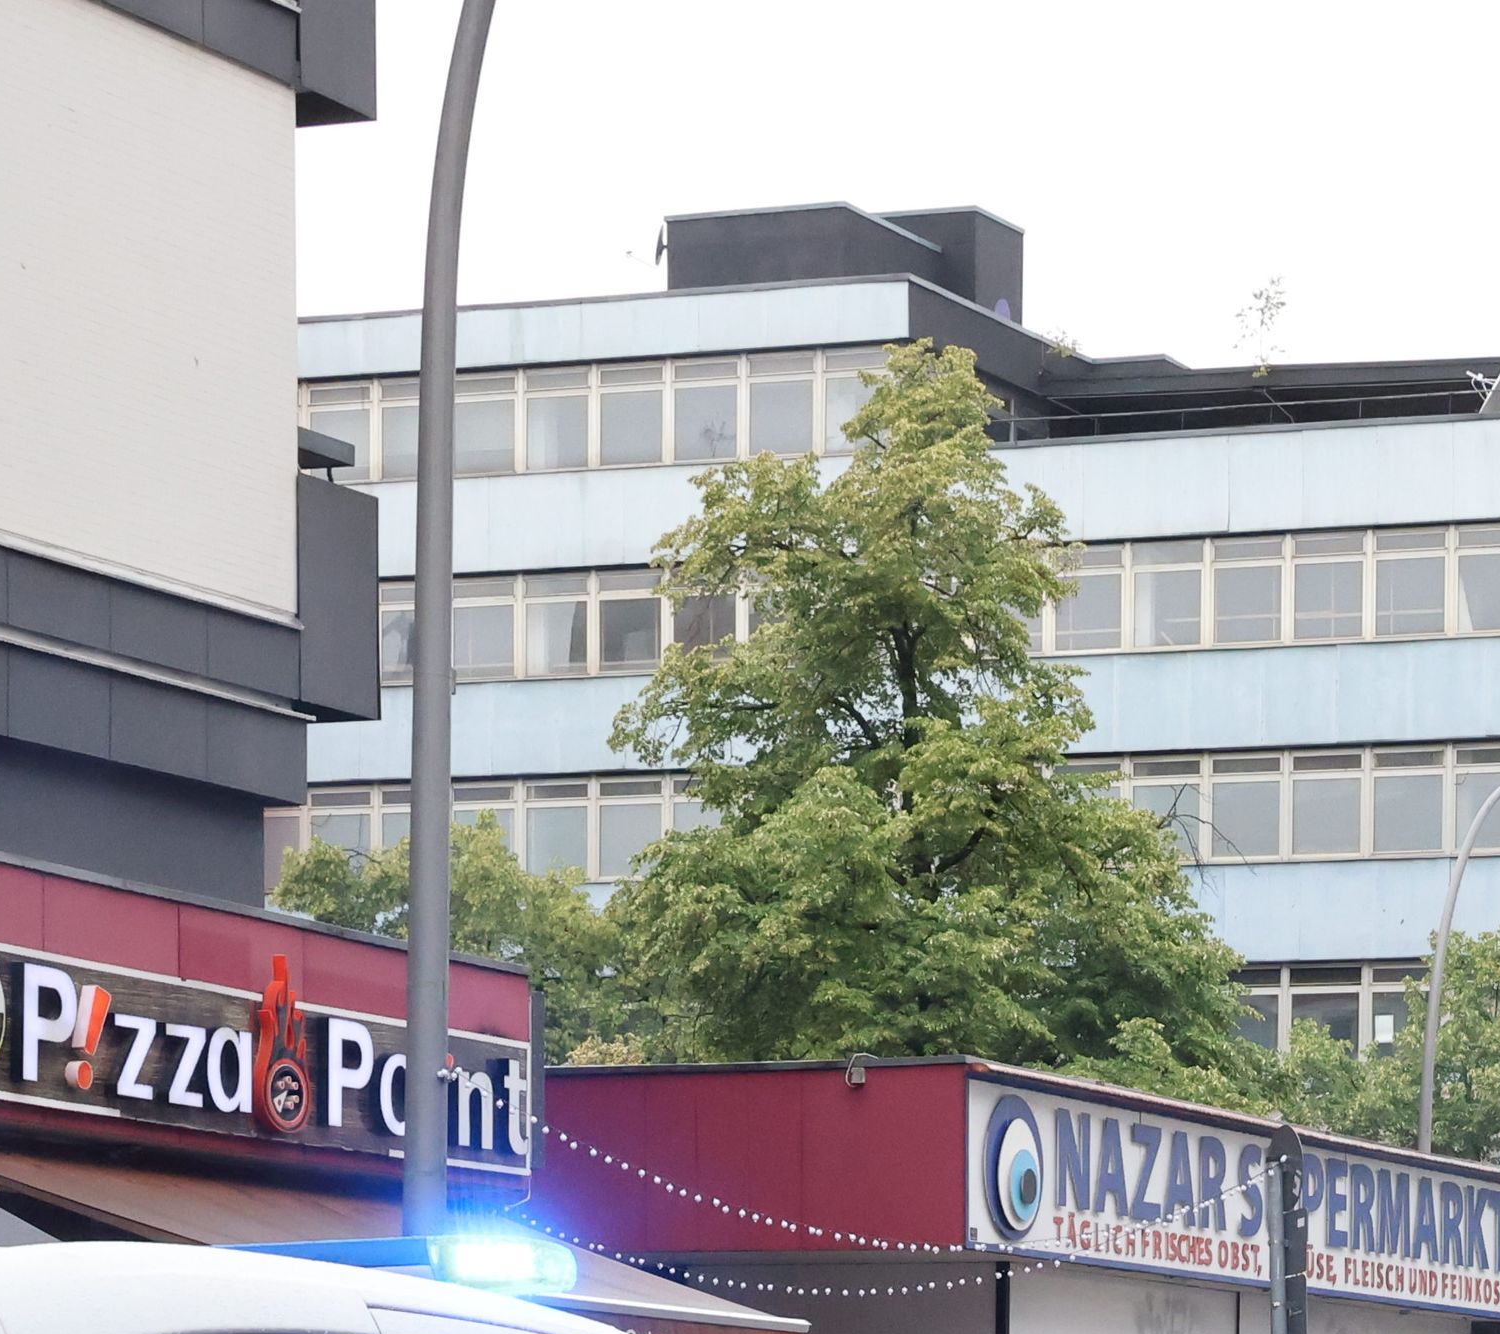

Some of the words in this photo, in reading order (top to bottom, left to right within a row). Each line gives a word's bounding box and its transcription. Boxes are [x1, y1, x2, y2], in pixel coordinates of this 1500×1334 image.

[327, 1016, 530, 1156] Pont
[1055, 1107, 1227, 1232] NAZAR
[1053, 1211, 1136, 1257] TÄGLICH
[1141, 1229, 1213, 1268] FRISCHES
[1344, 1256, 1405, 1293] FLEISCH
[1408, 1267, 1438, 1297] UND
